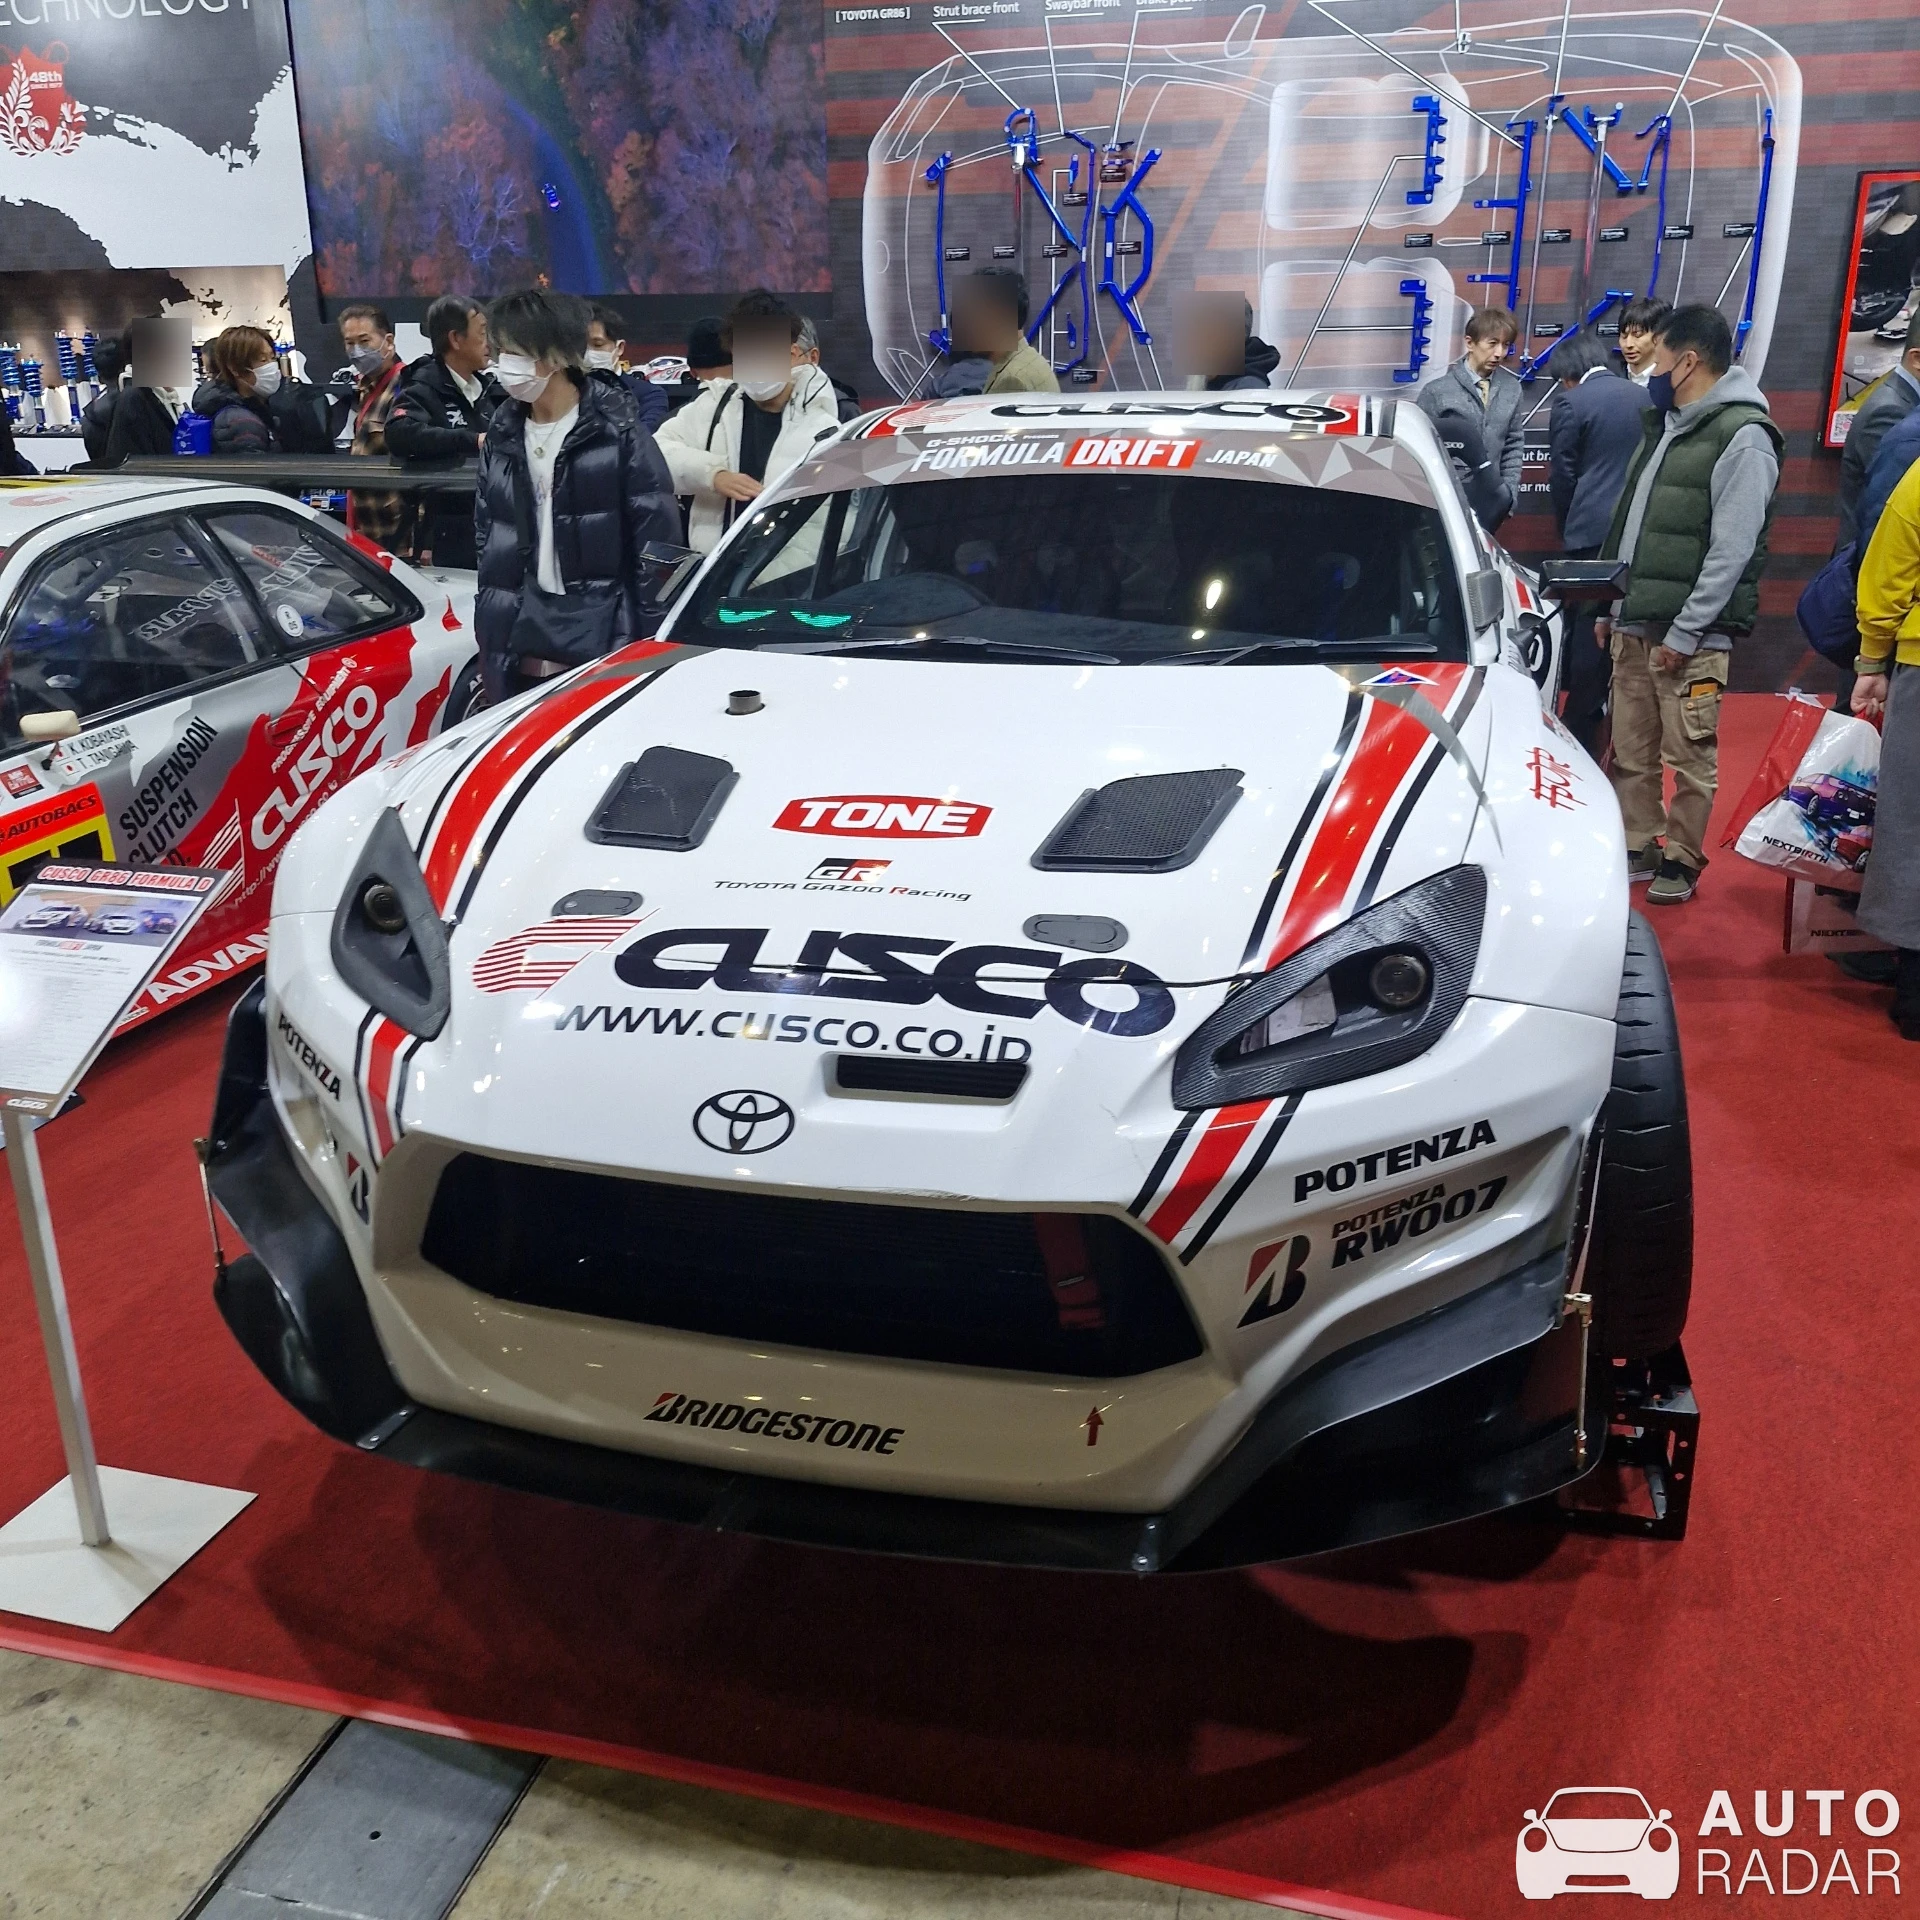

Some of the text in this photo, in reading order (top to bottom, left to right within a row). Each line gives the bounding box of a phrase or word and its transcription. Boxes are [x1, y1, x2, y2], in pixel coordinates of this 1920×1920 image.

[933, 1, 1020, 17] Strut brace front
[30, 71, 63, 83] 48th
[990, 401, 1347, 423] CUSCO
[910, 439, 1278, 473] FORMULA DRIFT JAPAN
[926, 434, 1018, 448] G-SHOCK
[119, 715, 220, 841] SUSPENSION
[251, 685, 378, 850] CUSCO
[7, 795, 98, 840] AUTOBACS
[799, 801, 978, 834] TONE
[1762, 835, 1830, 864] NEXTBIRTH
[40, 866, 89, 881] CUSCO
[90, 869, 131, 884] GR86
[130, 872, 196, 889] FORMULA
[714, 880, 972, 902] TOYOTA GAZOO Racing
[806, 866, 879, 882] GR
[614, 928, 1177, 1038] CUSCO
[553, 1004, 1034, 1065] www.cusco.co.jp
[279, 1013, 342, 1102] POTENZA
[1294, 1118, 1497, 1204] POTENZA
[1331, 1183, 1446, 1239] POTENZA
[1331, 1175, 1508, 1269] RW007
[643, 1392, 905, 1455] BRIDGESTONE
